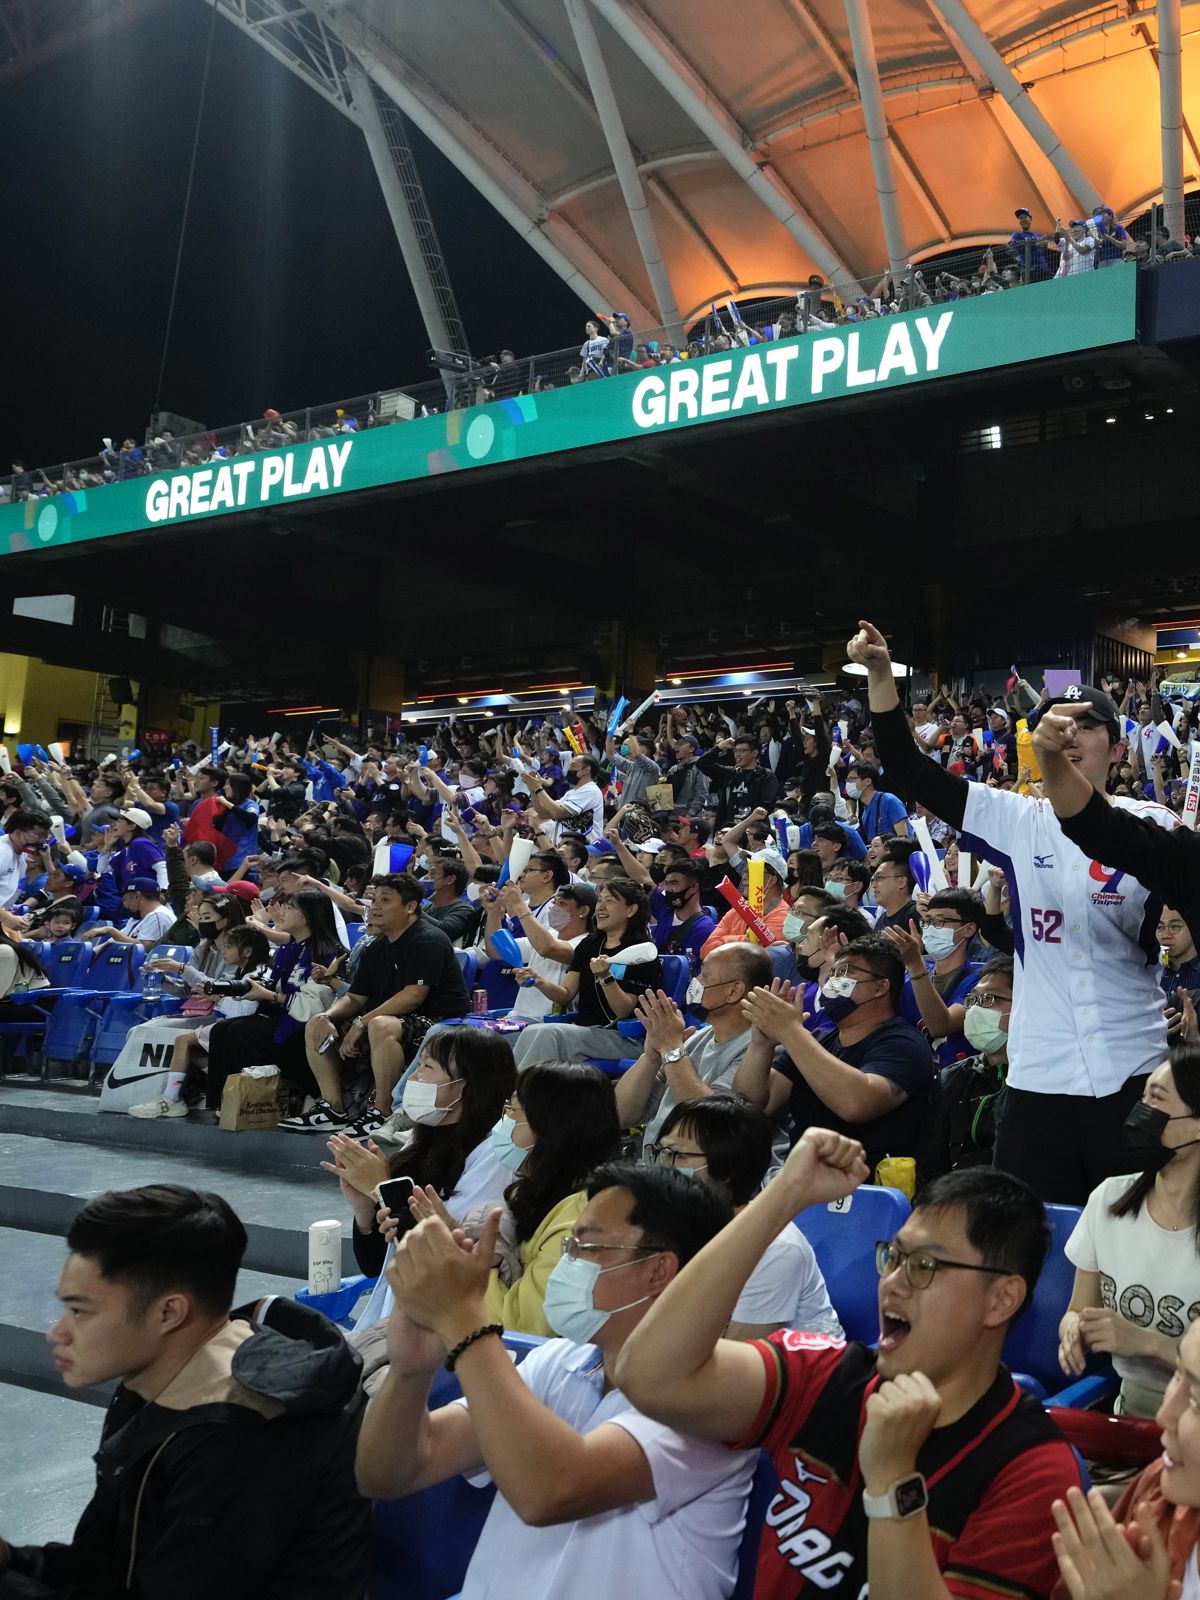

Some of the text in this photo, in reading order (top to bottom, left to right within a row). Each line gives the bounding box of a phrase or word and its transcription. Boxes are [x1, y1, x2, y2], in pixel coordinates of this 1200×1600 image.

[632, 304, 954, 429] GREAT PLAY
[145, 440, 353, 523] GREAT PLAY
[1187, 794, 1197, 812] A25
[1091, 892, 1126, 903] Chinese
[1030, 908, 1063, 944] 52
[139, 1043, 175, 1068] NI
[835, 1196, 845, 1211] 9
